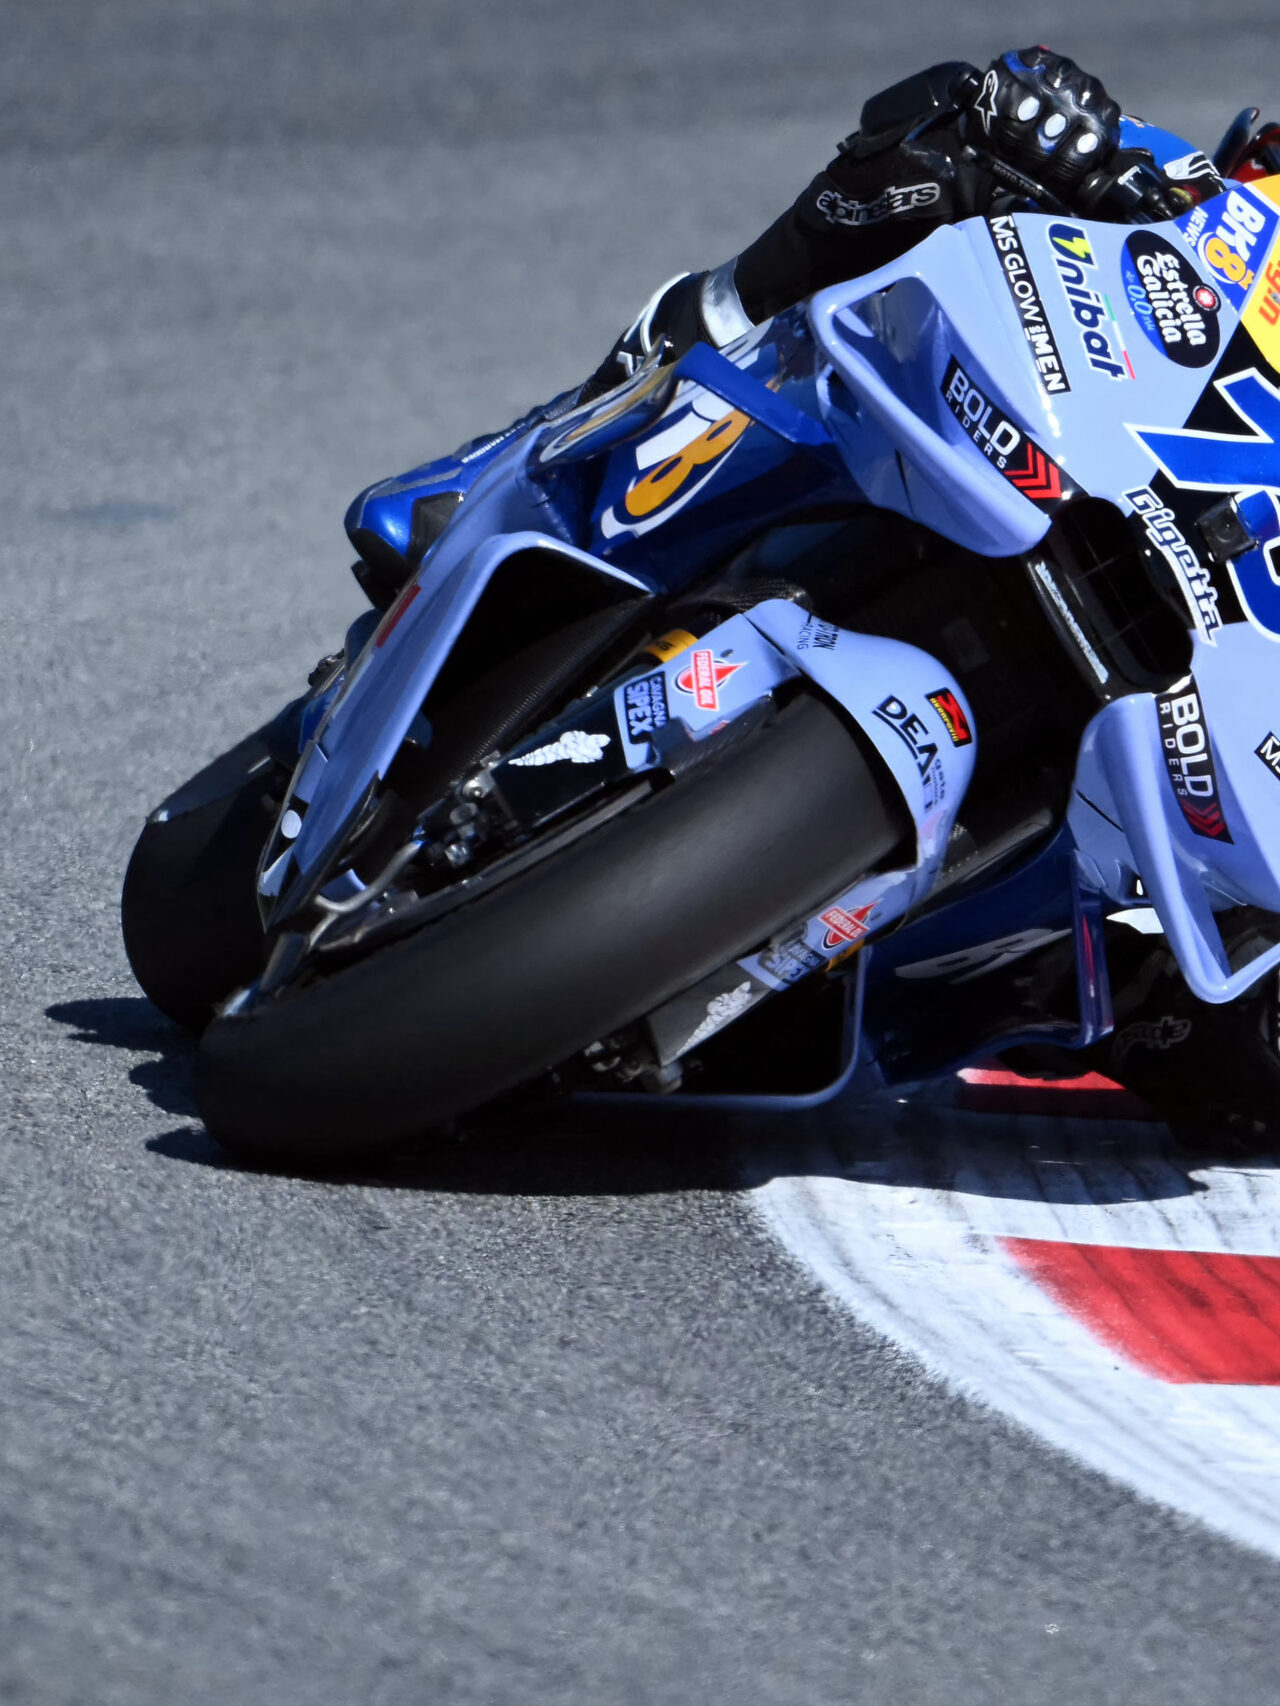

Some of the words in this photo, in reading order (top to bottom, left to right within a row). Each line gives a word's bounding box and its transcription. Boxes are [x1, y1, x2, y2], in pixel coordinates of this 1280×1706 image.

[1183, 206, 1209, 247] NEWS
[1204, 190, 1266, 284] BK8
[990, 215, 1018, 251] MS
[1004, 254, 1043, 322] GLOW
[1032, 333, 1066, 391] MEN
[1047, 221, 1128, 380] Unibat
[1136, 254, 1182, 344] Galicia
[1154, 251, 1207, 346] Estrella
[945, 390, 1008, 469] RIDERS
[949, 367, 1021, 456] BOLD
[694, 651, 711, 688] FEDERAL
[699, 688, 714, 706] OIL
[1159, 702, 1188, 796] RIDERS
[1170, 692, 1214, 797] BOLD
